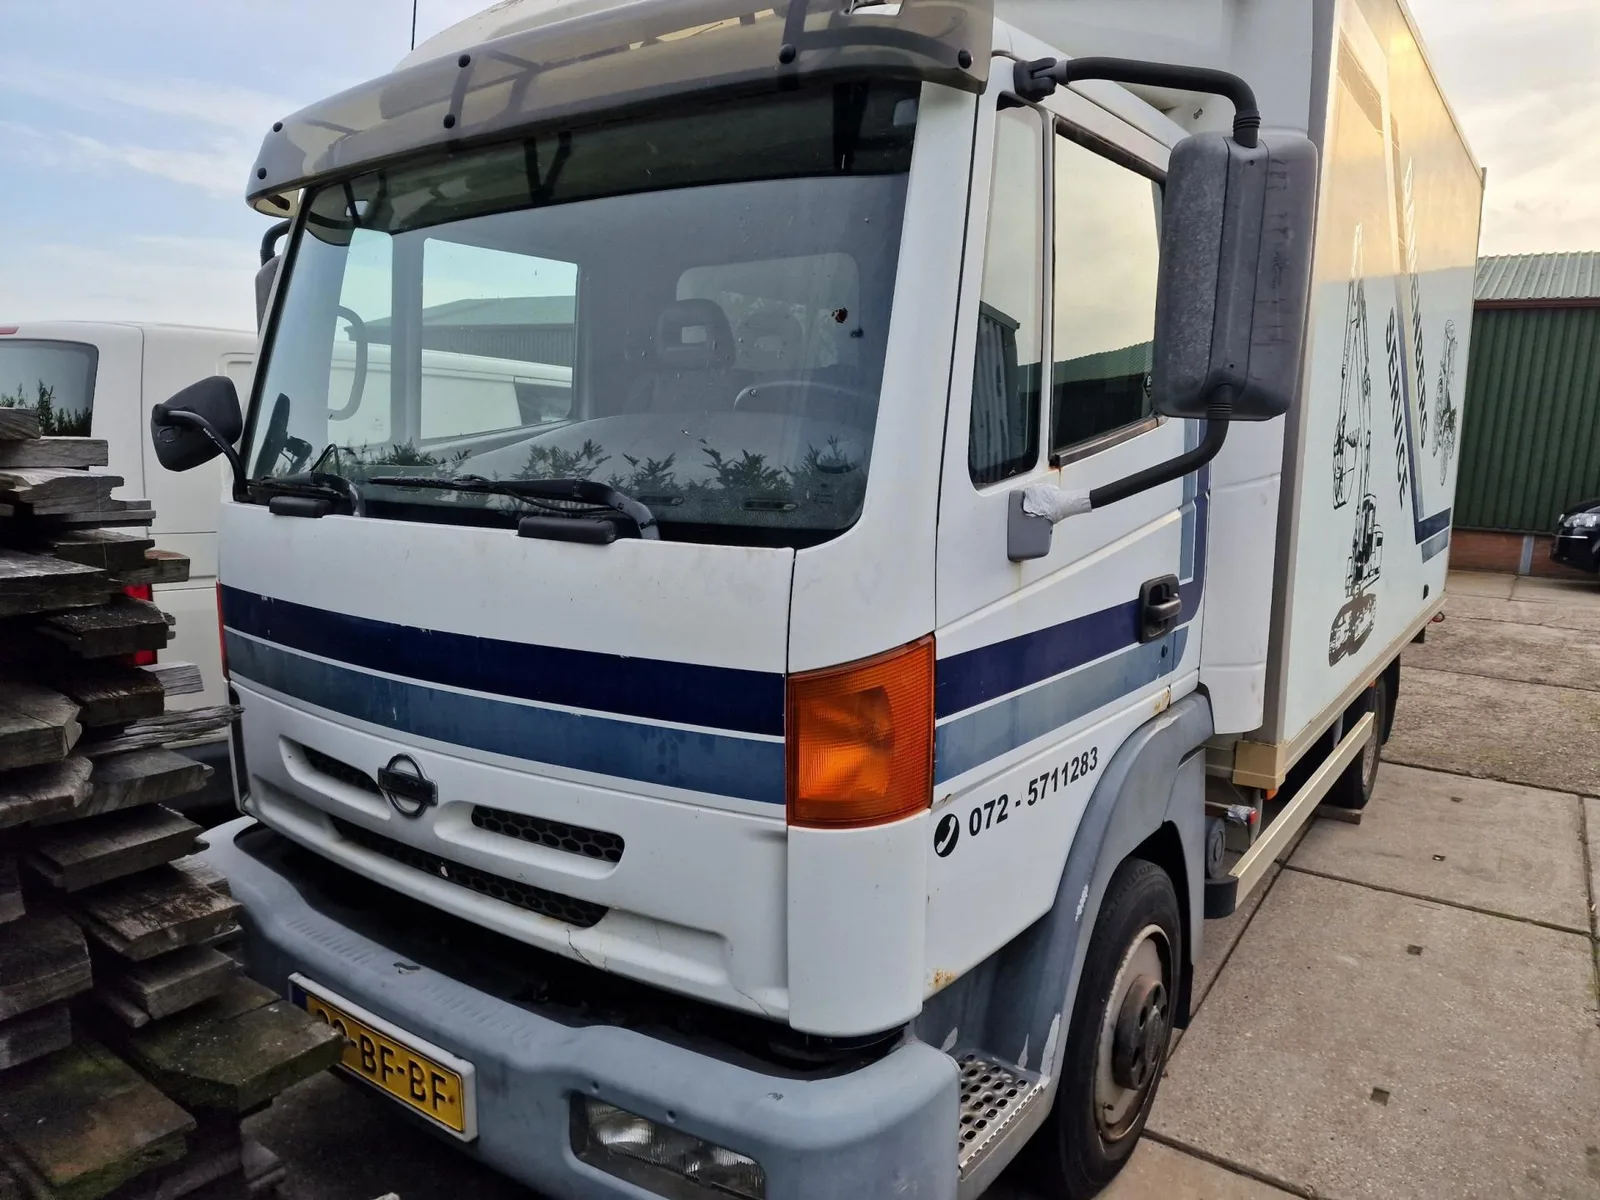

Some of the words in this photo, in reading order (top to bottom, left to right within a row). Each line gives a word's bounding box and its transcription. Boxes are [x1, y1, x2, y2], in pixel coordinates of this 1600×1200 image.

[1385, 306, 1408, 510] SERVICE
[969, 793, 1009, 837] 072
[1027, 746, 1098, 807] 5711283
